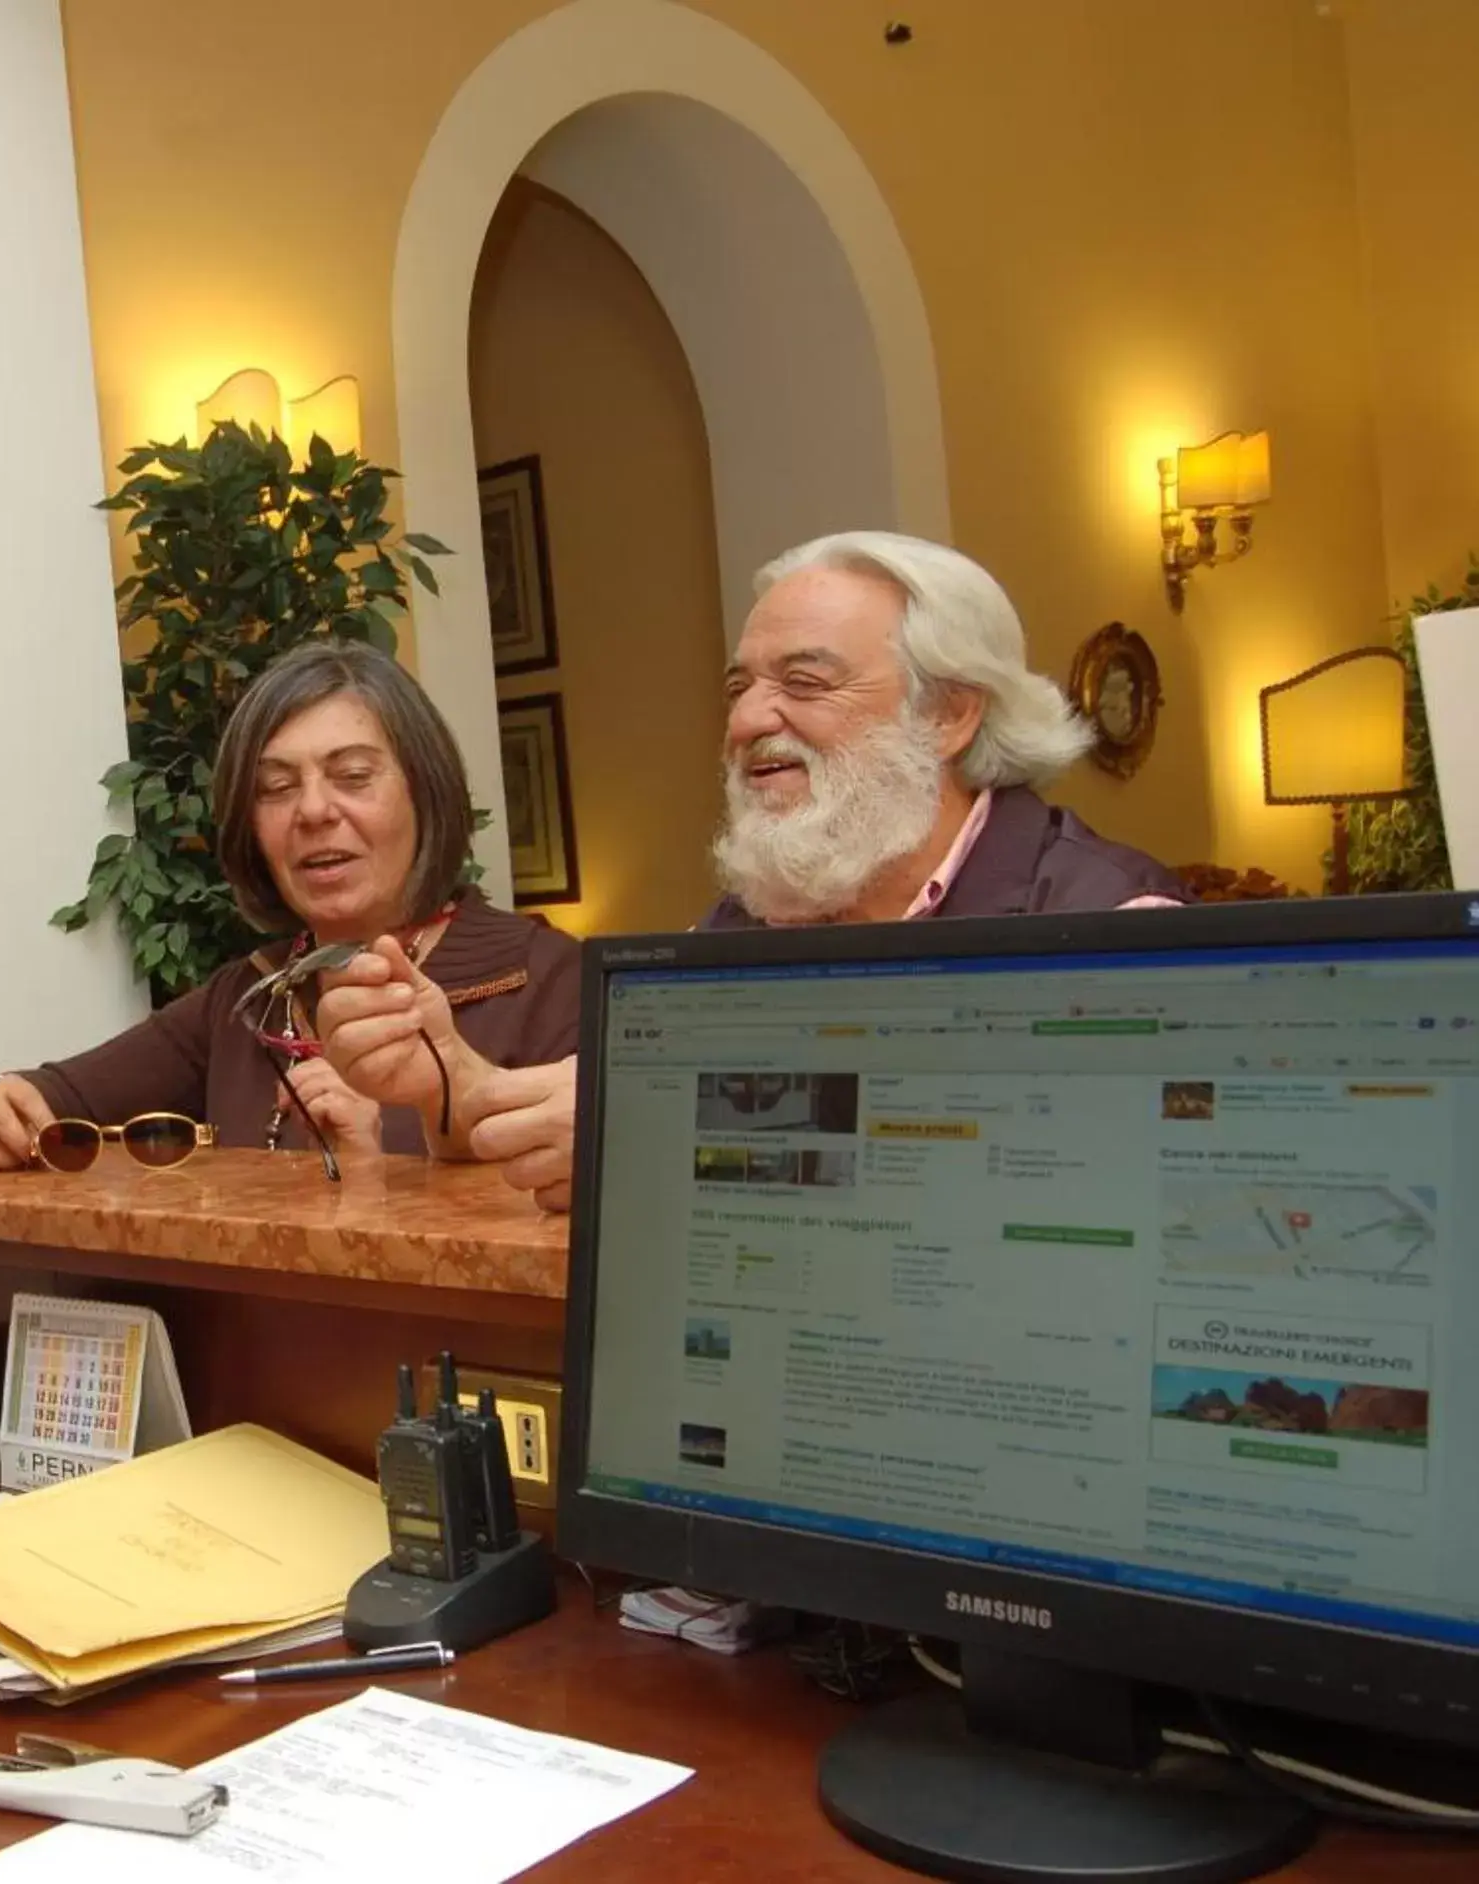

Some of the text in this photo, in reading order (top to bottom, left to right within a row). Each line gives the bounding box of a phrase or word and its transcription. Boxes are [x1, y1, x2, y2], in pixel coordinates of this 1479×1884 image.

[1167, 1337, 1413, 1372] DESTINAZIONI EMERGENTI
[945, 1590, 1052, 1629] SAMSUNG
